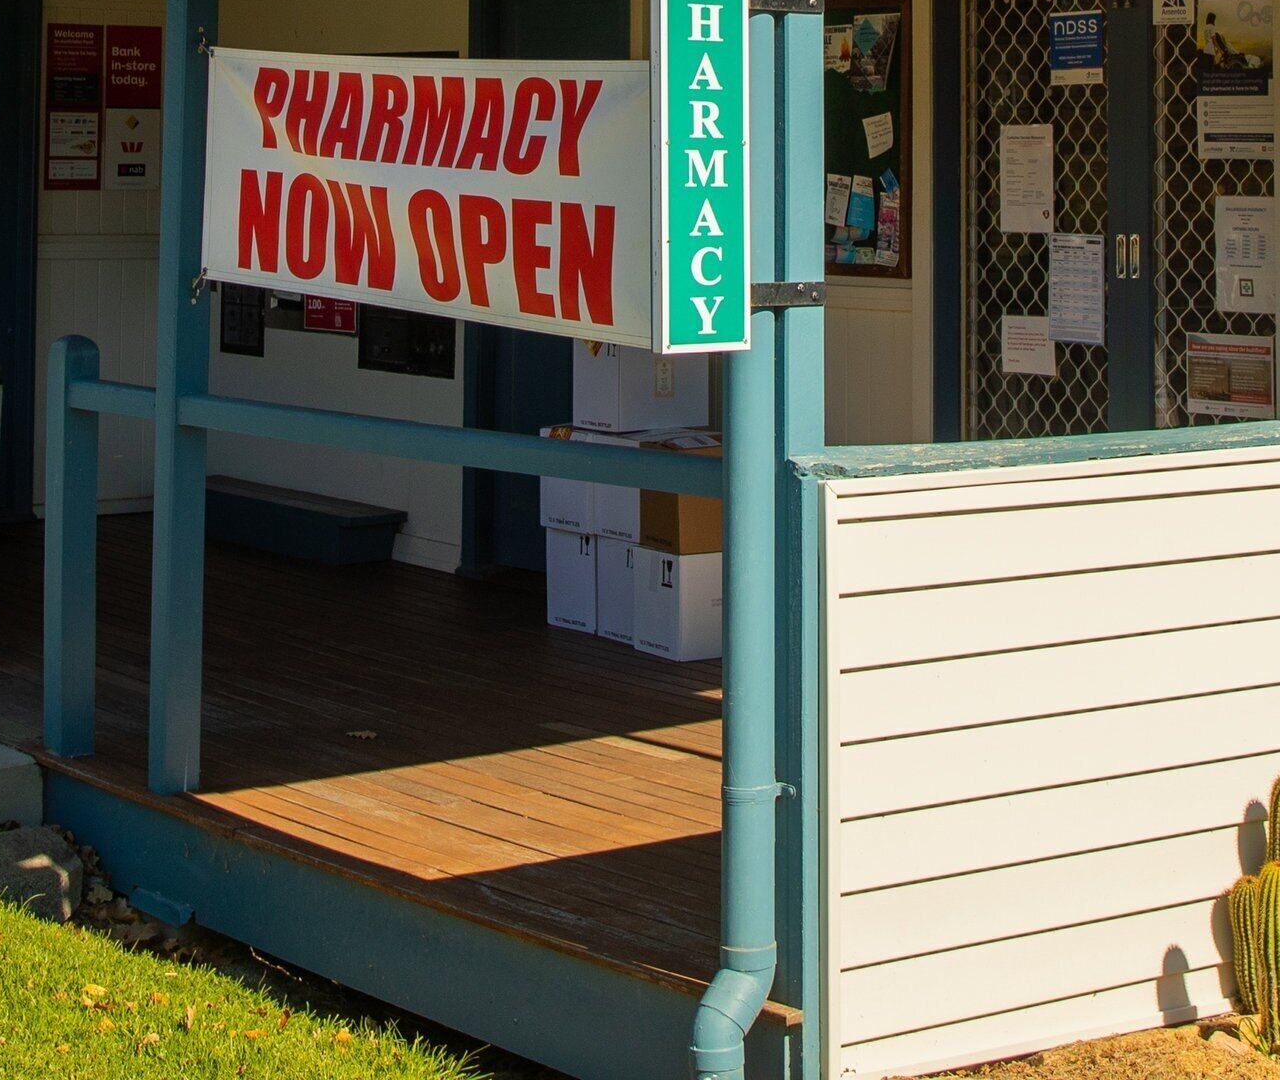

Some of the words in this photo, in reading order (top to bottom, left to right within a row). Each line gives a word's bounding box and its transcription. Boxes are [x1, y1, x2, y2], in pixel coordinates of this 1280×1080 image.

[111, 47, 141, 57] Bank
[111, 60, 157, 71] in-store
[111, 75, 148, 87] today.
[253, 66, 603, 177] PHARMACY
[238, 168, 396, 290] NOW
[407, 189, 615, 327] OPEN
